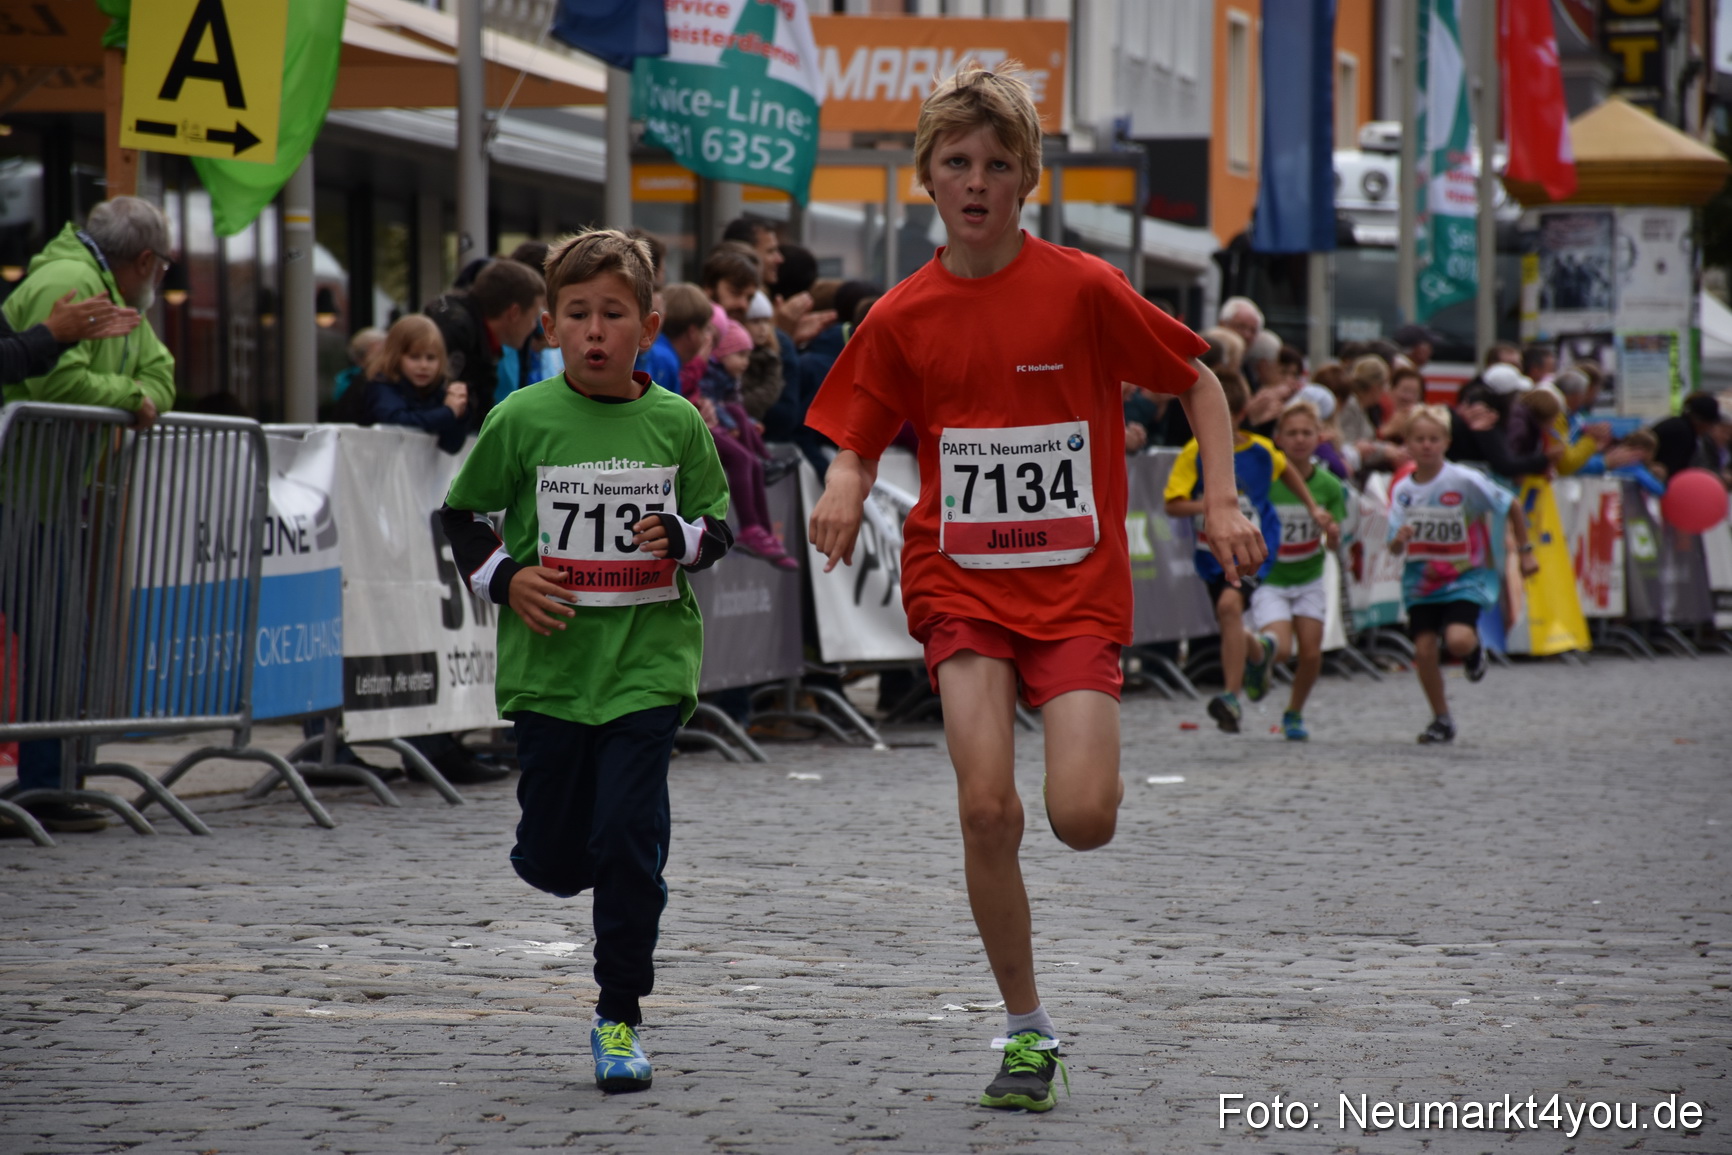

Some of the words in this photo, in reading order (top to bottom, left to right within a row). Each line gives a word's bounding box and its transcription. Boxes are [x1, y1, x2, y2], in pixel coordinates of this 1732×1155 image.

[157, 0, 247, 110] A
[702, 127, 796, 175] 6352
[943, 443, 987, 455] PARTL
[991, 440, 1061, 455] Neumarkt
[540, 480, 589, 494] PARTL
[593, 483, 659, 495] Neumarkt
[954, 459, 1079, 514] 7134
[552, 502, 664, 553] 713
[988, 528, 1047, 549] Julius
[1413, 521, 1462, 542] 7209
[557, 565, 660, 587] Maximilian
